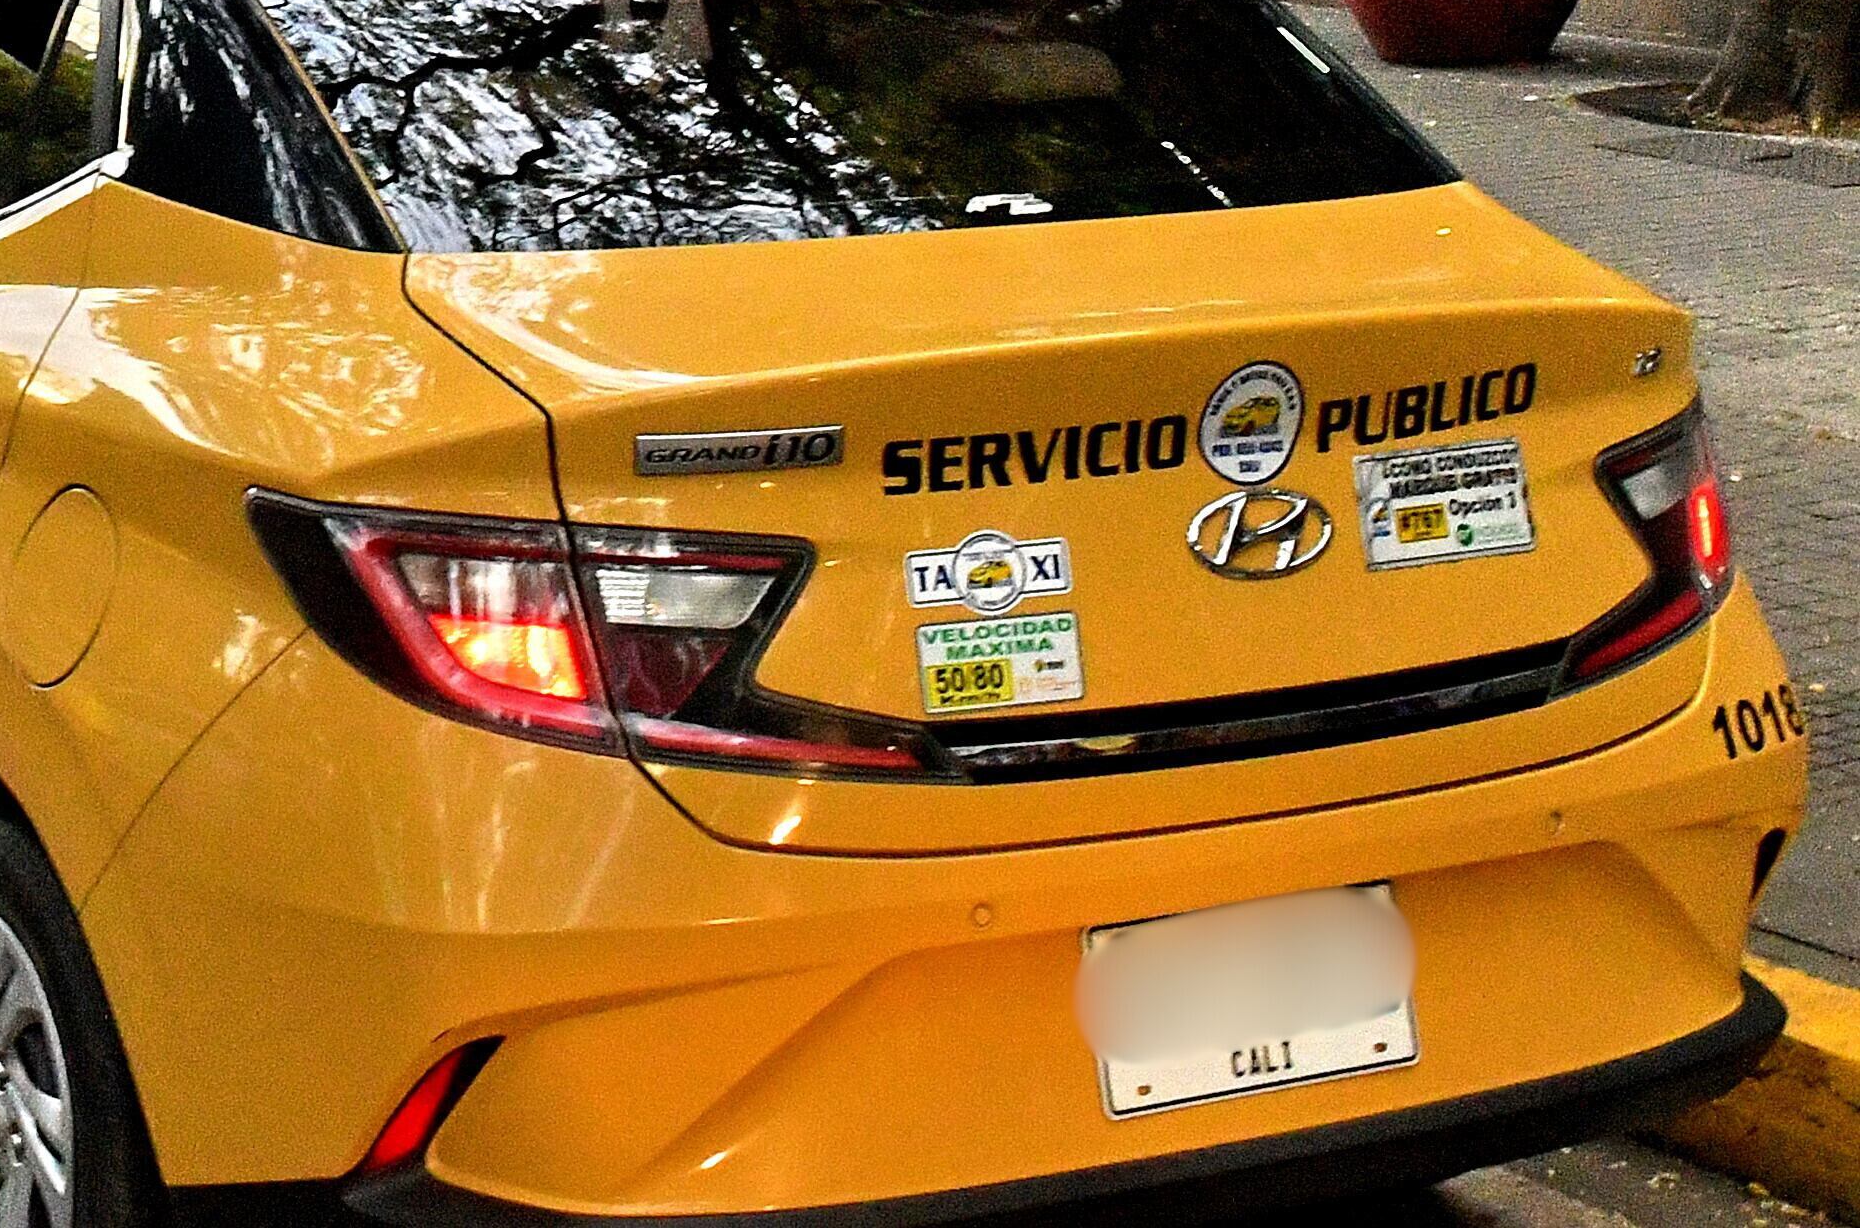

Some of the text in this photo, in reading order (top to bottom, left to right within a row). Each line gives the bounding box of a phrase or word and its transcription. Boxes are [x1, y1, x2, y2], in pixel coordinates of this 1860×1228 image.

[883, 414, 1187, 497] SERVICIO
[1316, 362, 1538, 453] PUBLICO
[645, 432, 836, 466] GRAND i10
[922, 617, 1073, 646] VELOCIDAD
[945, 637, 1054, 662] MAXIMA
[1230, 1040, 1293, 1079] CALI
